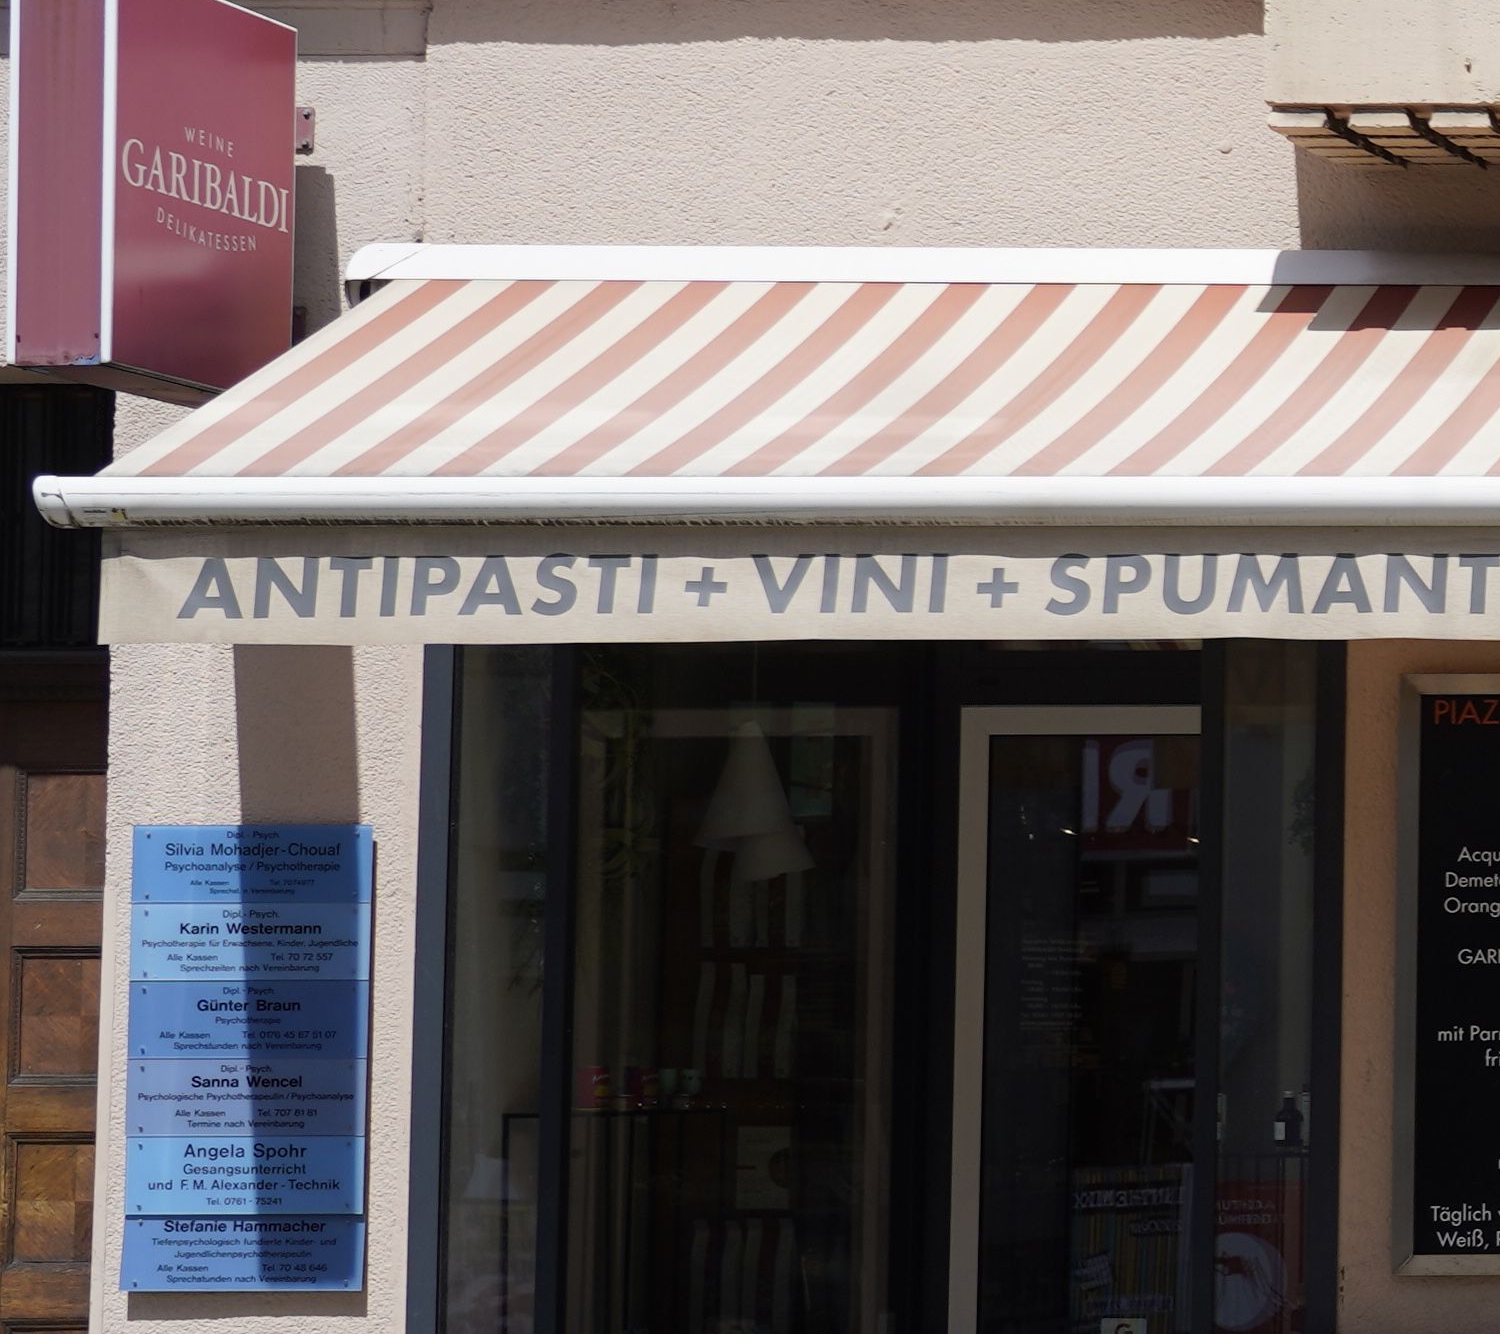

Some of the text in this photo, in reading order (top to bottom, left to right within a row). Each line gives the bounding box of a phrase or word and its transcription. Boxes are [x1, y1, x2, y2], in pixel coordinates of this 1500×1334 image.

[183, 126, 235, 157] WEINE
[121, 137, 290, 233] GARIBALDI
[155, 205, 258, 252] DELIKATESSEN
[180, 554, 655, 619] ANTIPASTI
[754, 554, 946, 613] VINI
[165, 842, 205, 857] Silvia
[165, 861, 340, 872] Psychoanalyse Psychotherapie
[180, 923, 322, 935] Karin Westermann
[141, 940, 207, 948] Psychotherapie
[197, 999, 301, 1012] Günter Braun
[1437, 1025, 1465, 1042] mit
[191, 1075, 303, 1088] Sanna Wencel
[184, 1144, 308, 1161] Angela Spohr
[183, 1164, 307, 1177] Gesangsunterricht
[148, 1180, 173, 1191] und
[193, 1180, 208, 1191] M.
[1430, 1202, 1492, 1227] Täglich
[163, 1220, 326, 1233] Stefanie Hammacher
[1436, 1228, 1489, 1250] Weiß,
